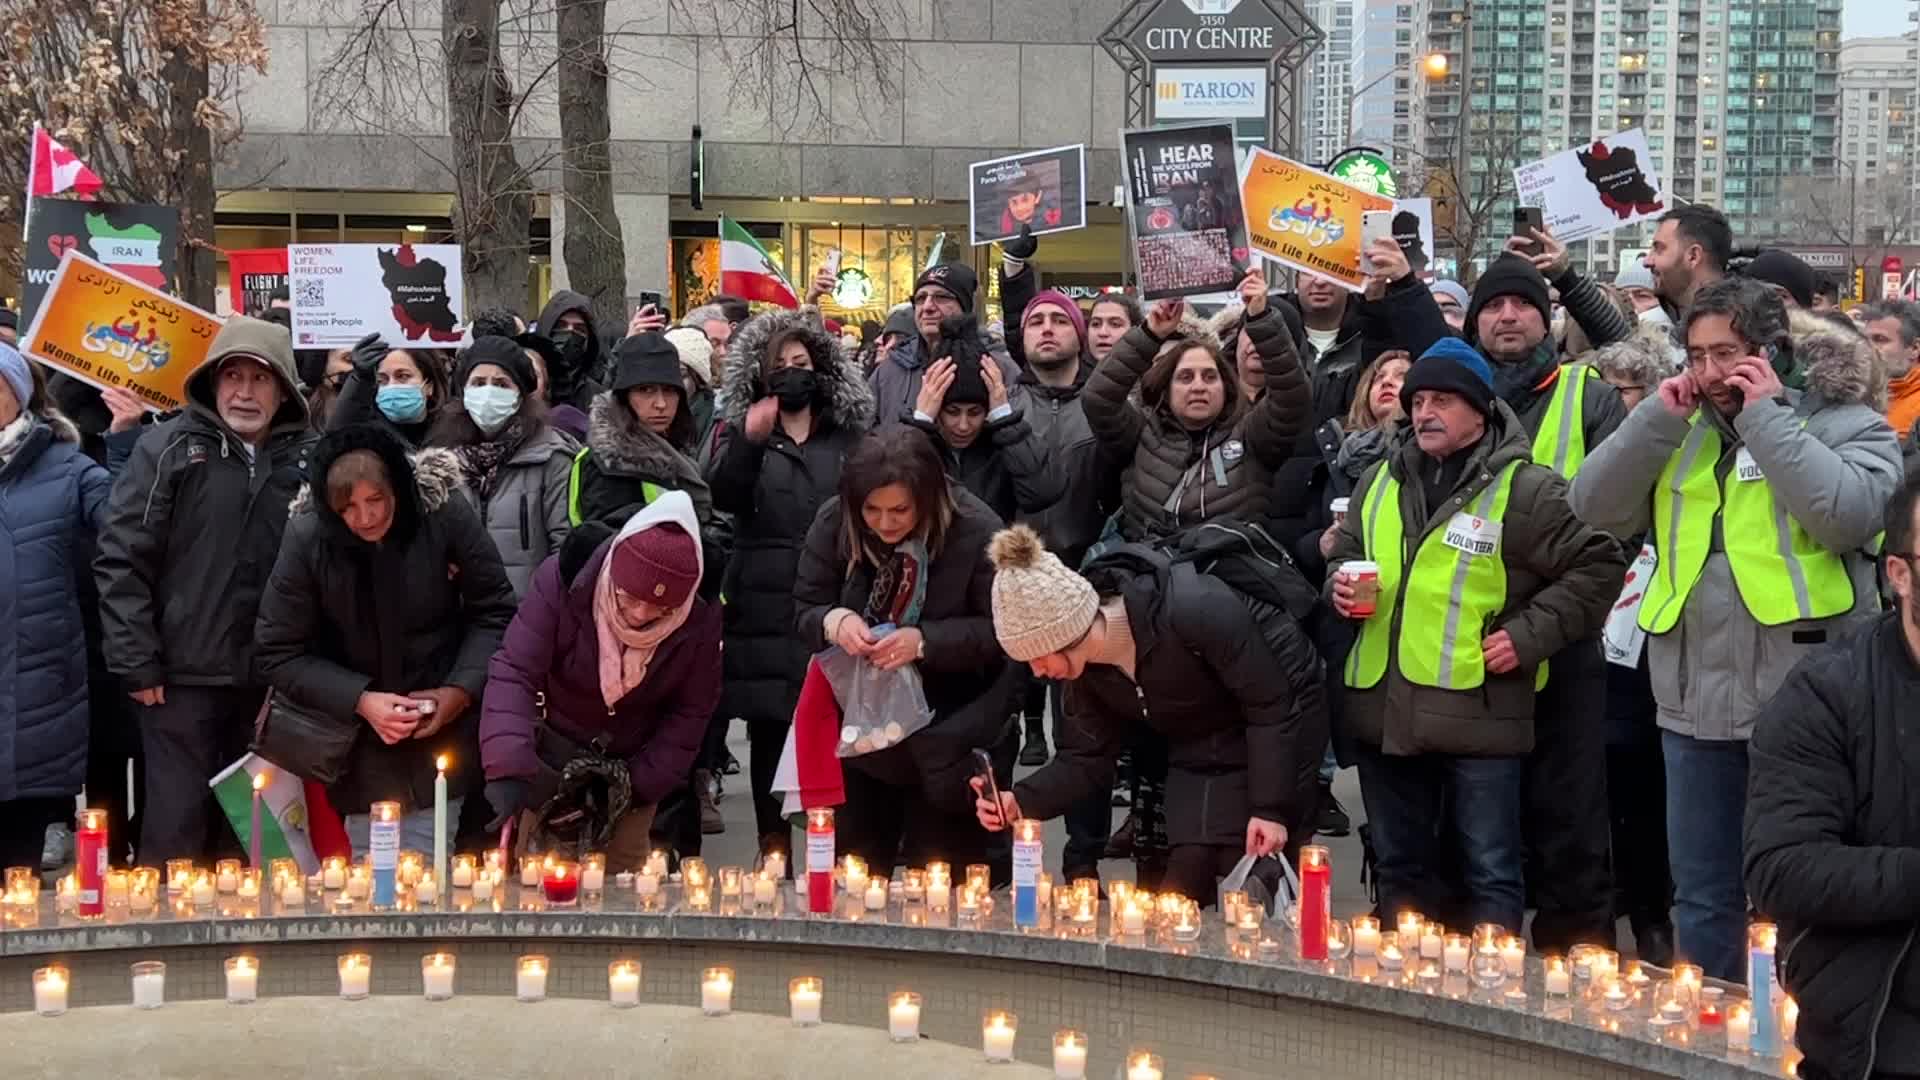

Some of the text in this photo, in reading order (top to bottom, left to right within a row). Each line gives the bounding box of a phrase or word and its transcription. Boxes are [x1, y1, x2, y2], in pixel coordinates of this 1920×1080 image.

[1200, 15, 1226, 26] 5150
[1146, 27, 1273, 50] CITY CENTRE
[1182, 82, 1255, 98] TARION
[1160, 144, 1214, 164] HEAR
[1191, 161, 1212, 169] FROM
[1152, 169, 1199, 187] IRAN
[1555, 213, 1581, 227] People
[112, 246, 143, 257] IRAN
[1249, 231, 1357, 279] man Life Freedom
[27, 268, 57, 284] WO
[294, 266, 343, 275] FREEDOM
[245, 274, 279, 290] FLIGHT
[297, 318, 363, 327] Iranian People
[42, 340, 93, 371] Woman
[97, 365, 121, 385] Life
[1740, 465, 1761, 478] VOL
